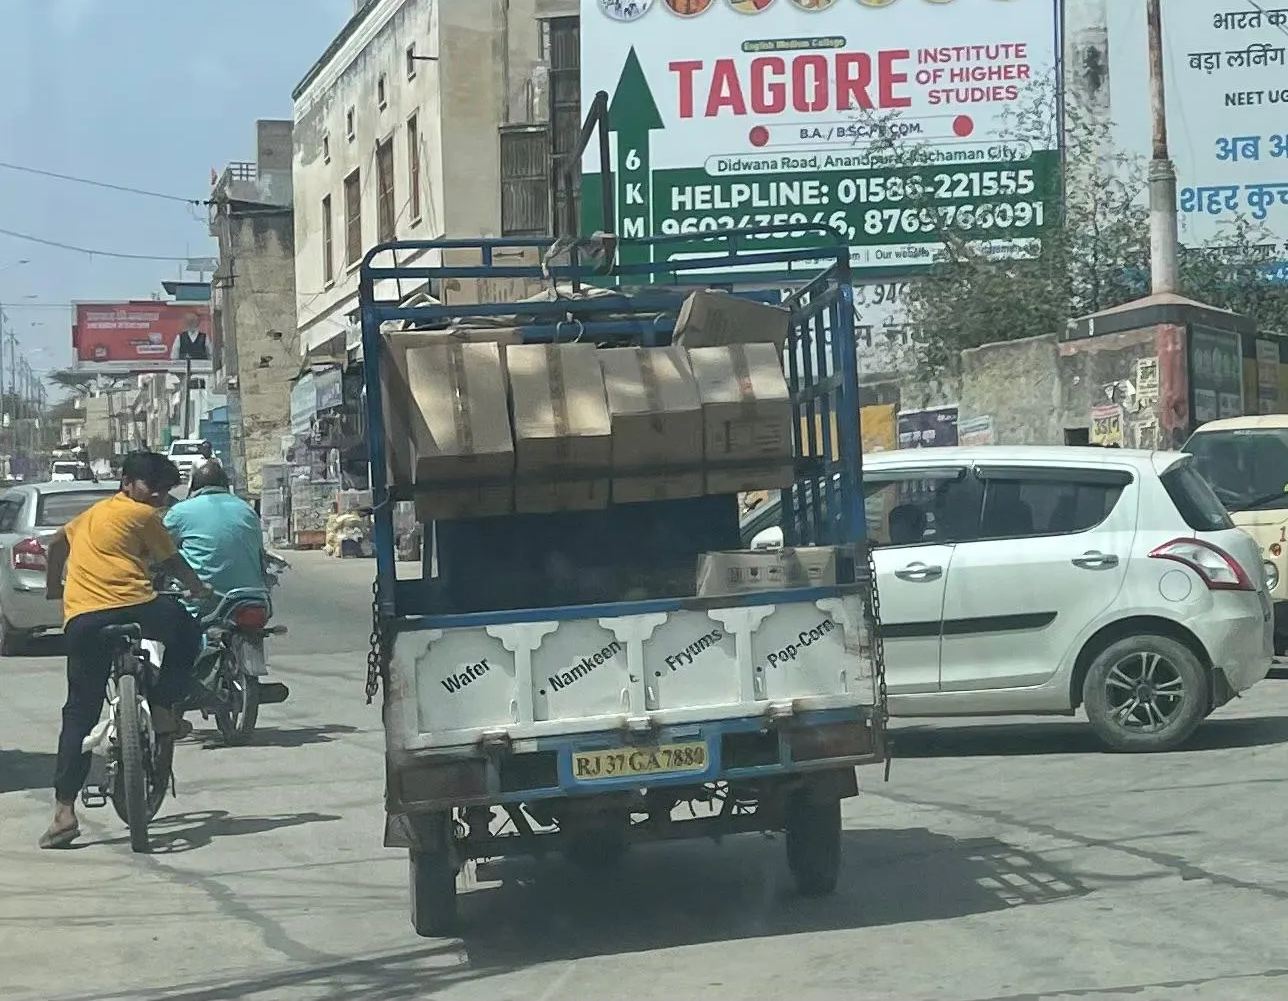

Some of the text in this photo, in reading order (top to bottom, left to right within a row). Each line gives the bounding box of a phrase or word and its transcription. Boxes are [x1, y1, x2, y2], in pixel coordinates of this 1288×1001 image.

[1213, 8, 1262, 31] भारत
[917, 43, 1028, 64] INSTITUTE
[1187, 50, 1221, 75] बड़ा
[669, 49, 912, 118] TAGORE
[916, 64, 1030, 85] OF HIGHER
[928, 85, 1018, 105] STUDIES
[1225, 90, 1266, 107] NEET
[1215, 135, 1261, 162] अब
[717, 155, 778, 172] Didwana
[781, 153, 821, 173] Road,
[671, 169, 1036, 211] HELPLINE: 01586-221555
[1179, 185, 1239, 215] शहर
[664, 627, 724, 673] Fryums
[766, 617, 836, 670] Pop-Corn
[440, 656, 491, 695] Wafer
[547, 640, 623, 693] Namkeen
[576, 757, 600, 776] RJ
[606, 754, 626, 774] 37
[629, 750, 661, 772] GA
